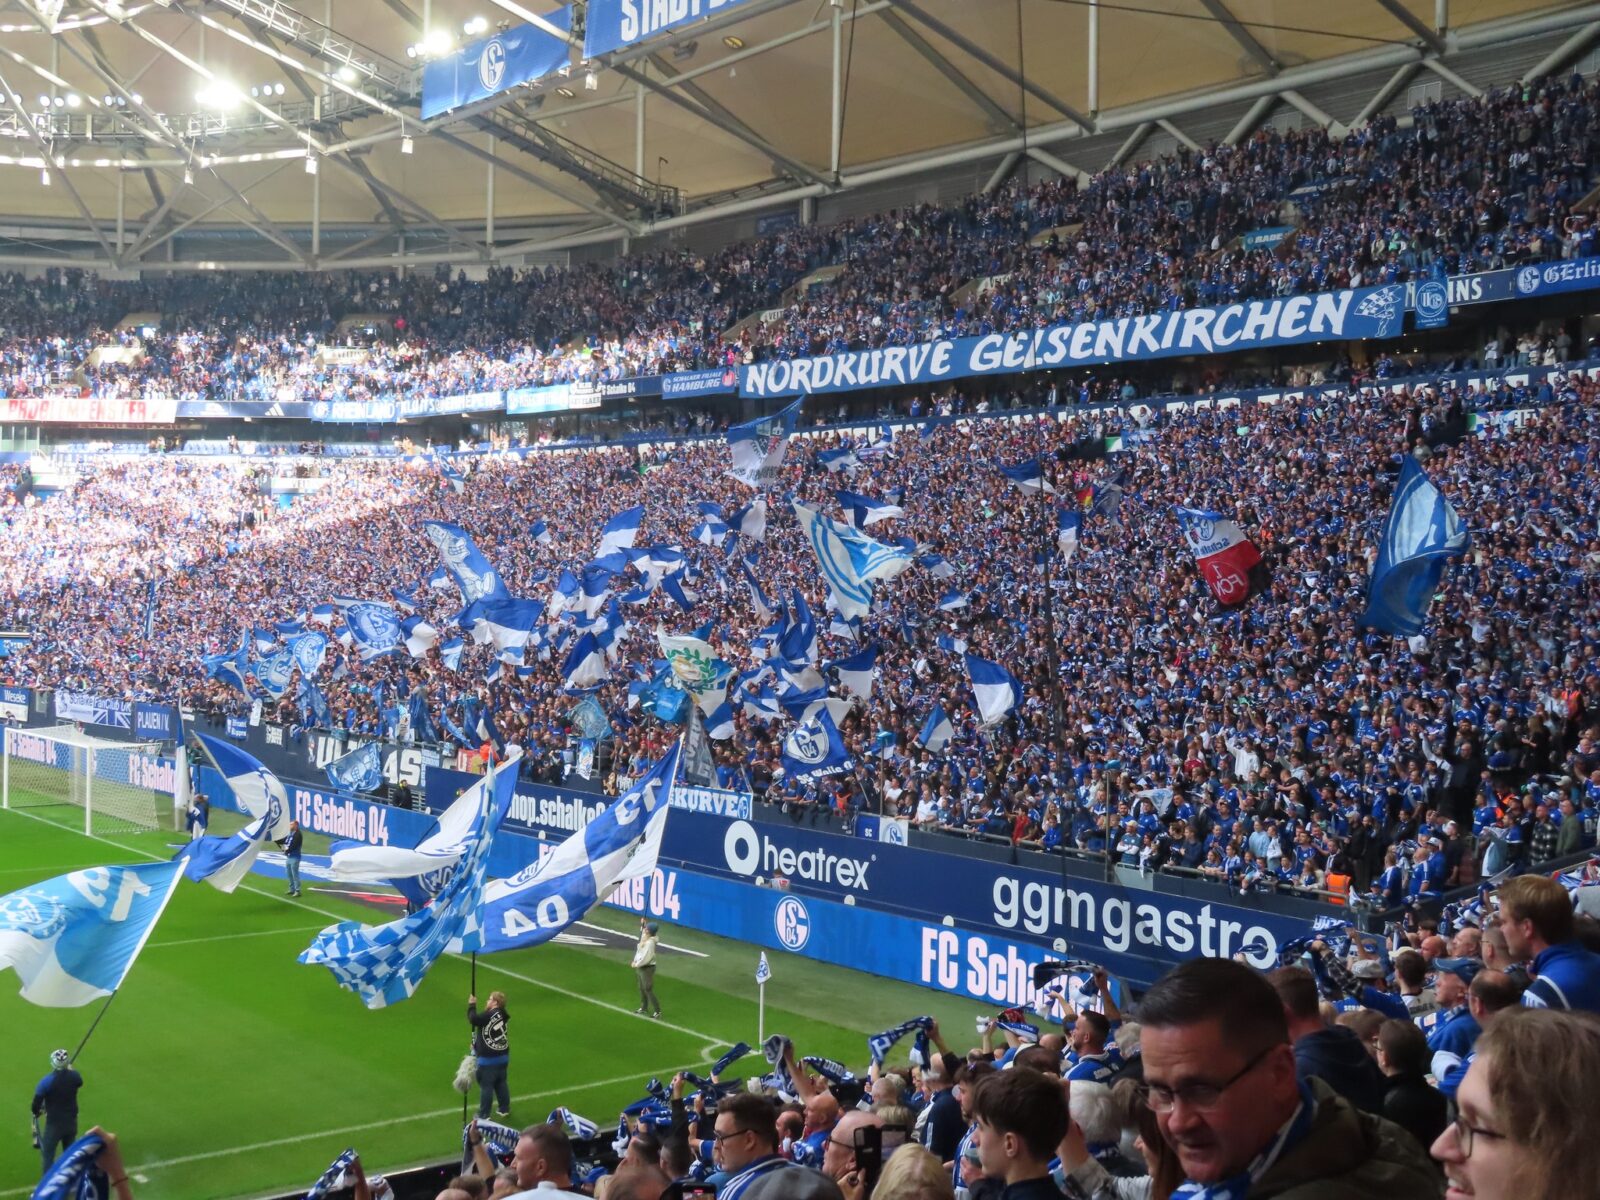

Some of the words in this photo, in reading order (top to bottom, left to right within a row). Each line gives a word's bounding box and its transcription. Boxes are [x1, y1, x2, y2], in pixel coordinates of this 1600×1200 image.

[746, 341, 953, 395] NORDKURVE
[969, 289, 1354, 370] GELSENKIRCHEN
[672, 378, 722, 392] HAMBURG
[137, 711, 160, 730] PLAUEN
[296, 790, 311, 828] FC
[313, 797, 366, 841] Schalke
[368, 806, 389, 846] 04
[764, 835, 869, 890] heatrex
[650, 867, 680, 920] 04
[992, 876, 1278, 970] ggmgastro
[922, 927, 959, 990] FC
